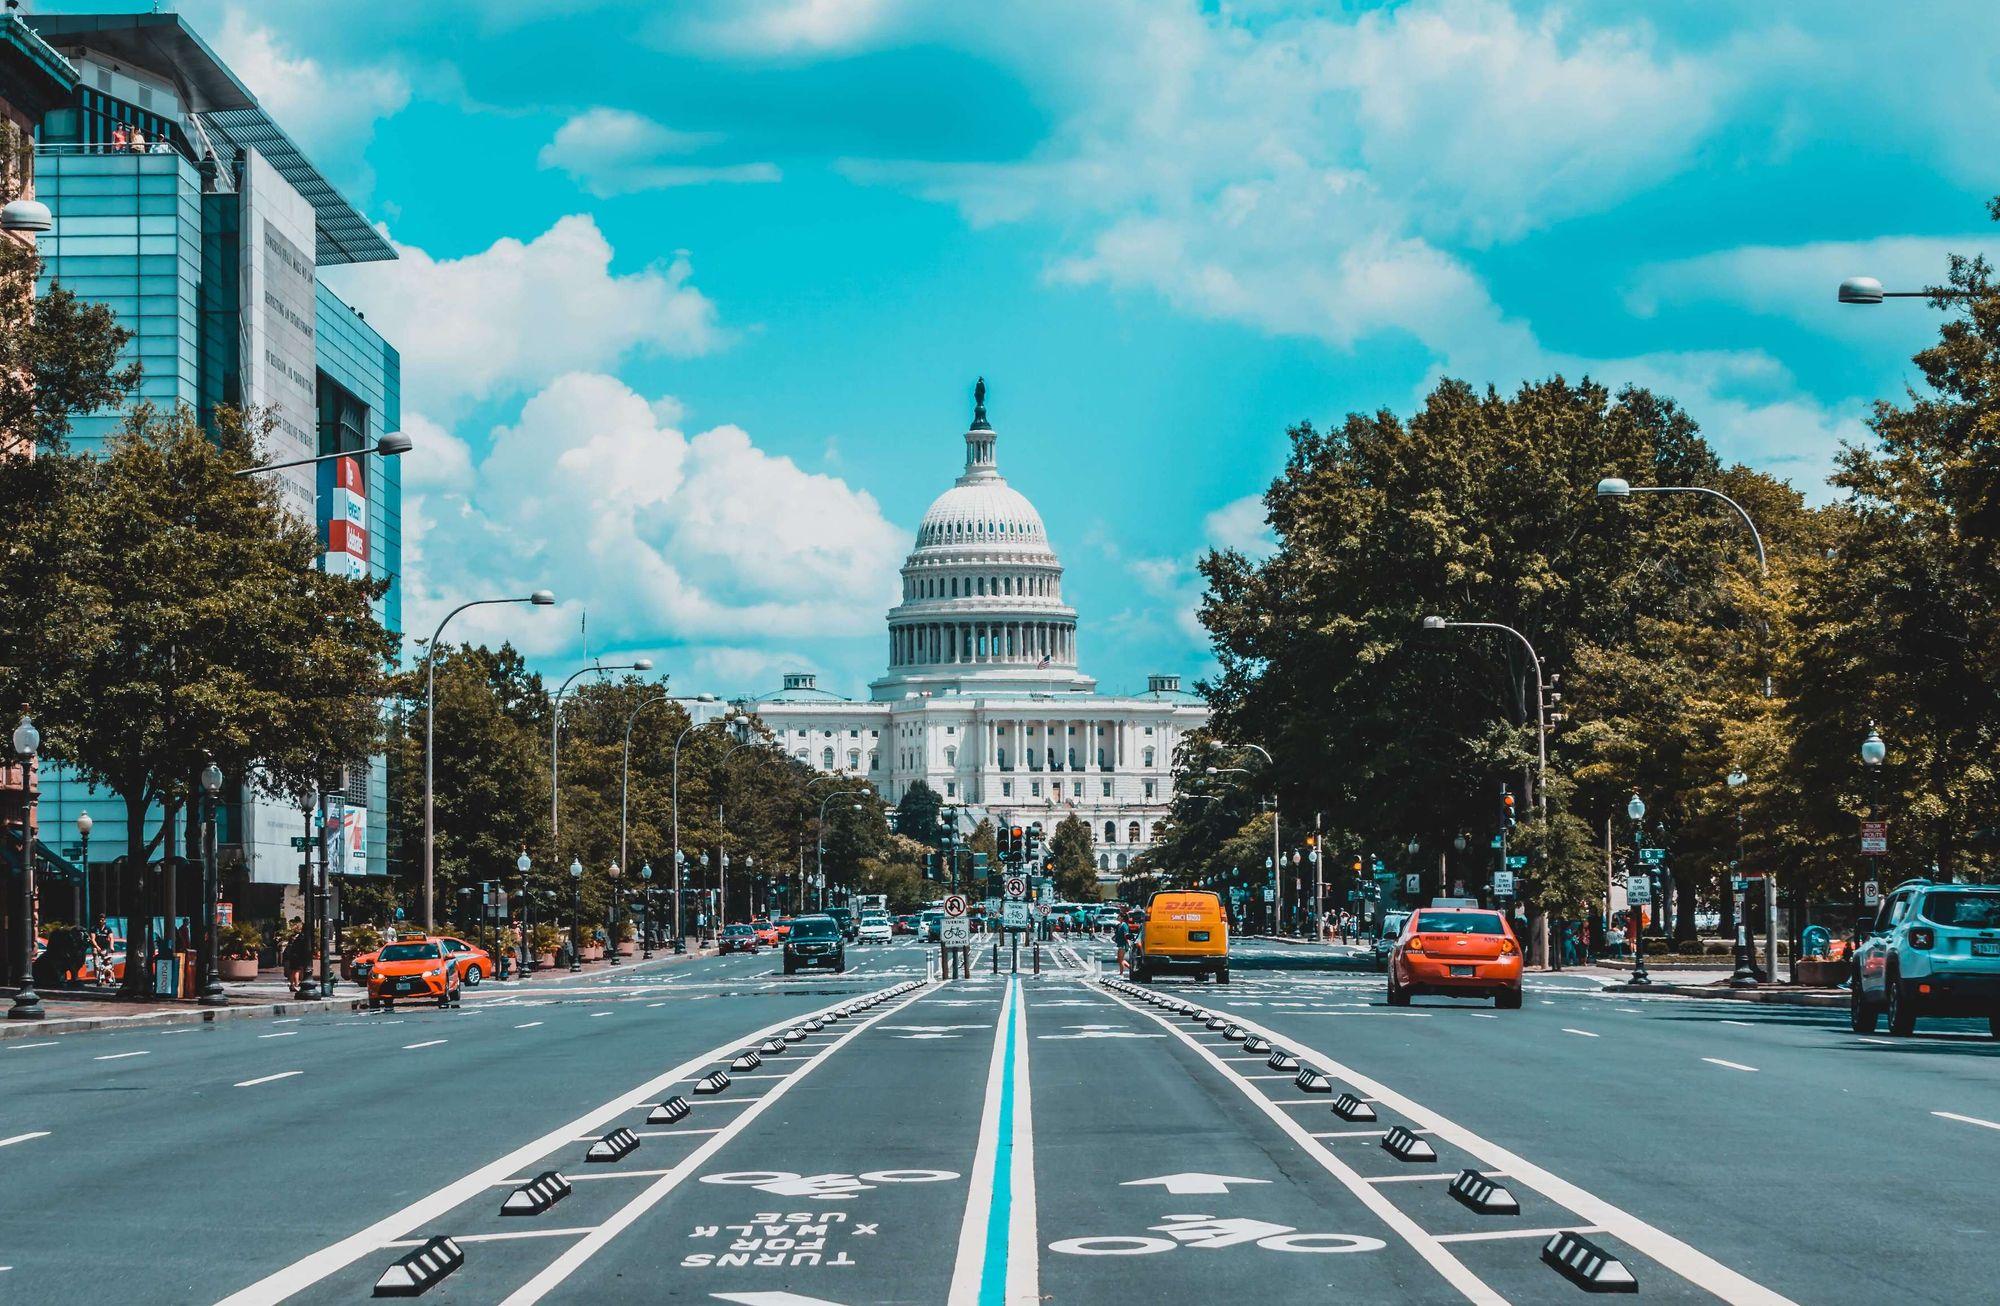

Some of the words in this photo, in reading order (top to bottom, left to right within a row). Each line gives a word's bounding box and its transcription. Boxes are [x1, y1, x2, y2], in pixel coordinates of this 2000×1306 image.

[1165, 902, 1207, 911] DHL
[750, 1212, 847, 1223] USE
[688, 1224, 828, 1237] WALK
[851, 1223, 879, 1235] X
[729, 1238, 827, 1251] FOR
[680, 1251, 856, 1267] TURNS
